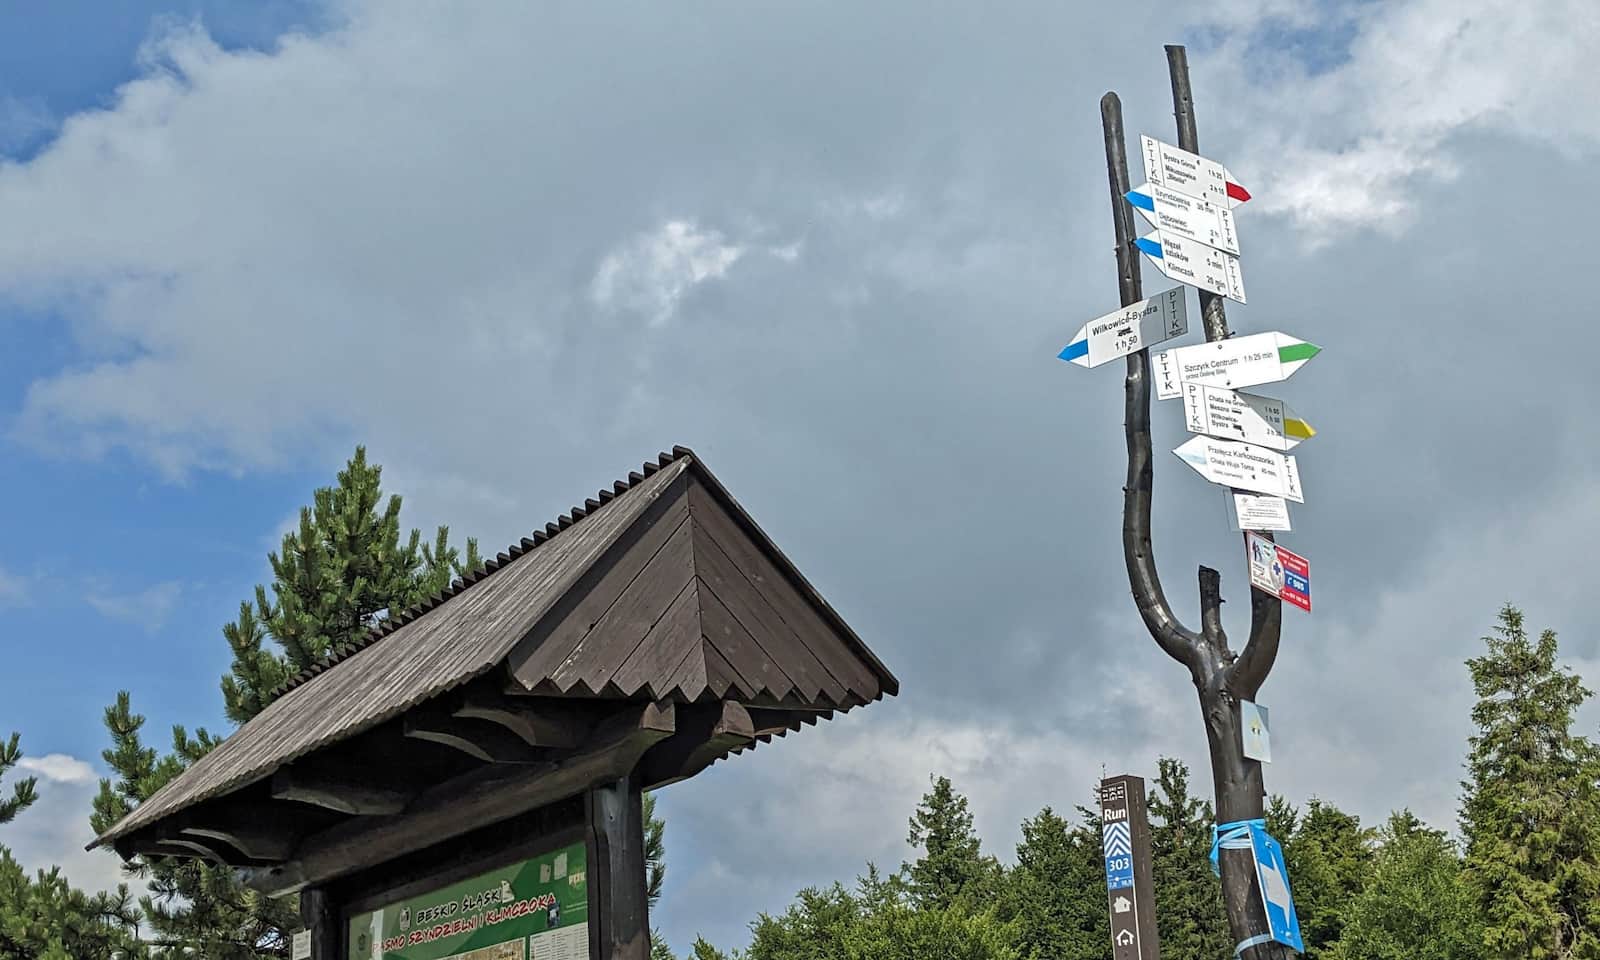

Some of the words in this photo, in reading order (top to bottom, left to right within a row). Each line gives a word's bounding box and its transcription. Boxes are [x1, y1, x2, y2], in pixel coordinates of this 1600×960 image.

[1147, 139, 1158, 178] PTTK
[1222, 210, 1233, 245] PTTK
[1167, 262, 1194, 277] Klimczok
[1211, 261, 1223, 270] min
[1228, 255, 1239, 294] PTTK
[1092, 304, 1158, 336] Wilkowice-Bystra
[1169, 290, 1180, 329] PTTK
[1121, 339, 1127, 348] h
[1160, 353, 1173, 390] PTTK
[1184, 360, 1210, 373] Szczyrk
[1210, 358, 1239, 368] Centrum
[1262, 352, 1273, 360] min
[1188, 385, 1200, 425] PTTK
[1208, 394, 1224, 403] Chata
[1211, 419, 1229, 429] Bystra
[1284, 455, 1296, 493] PTTK
[1104, 808, 1126, 821] Run
[1109, 858, 1130, 872] 303
[372, 934, 406, 953] PSMO
[408, 915, 478, 947] SZYNDZIELNI
[486, 892, 555, 925] KLIMCZOKA
[416, 901, 459, 925] BESKID
